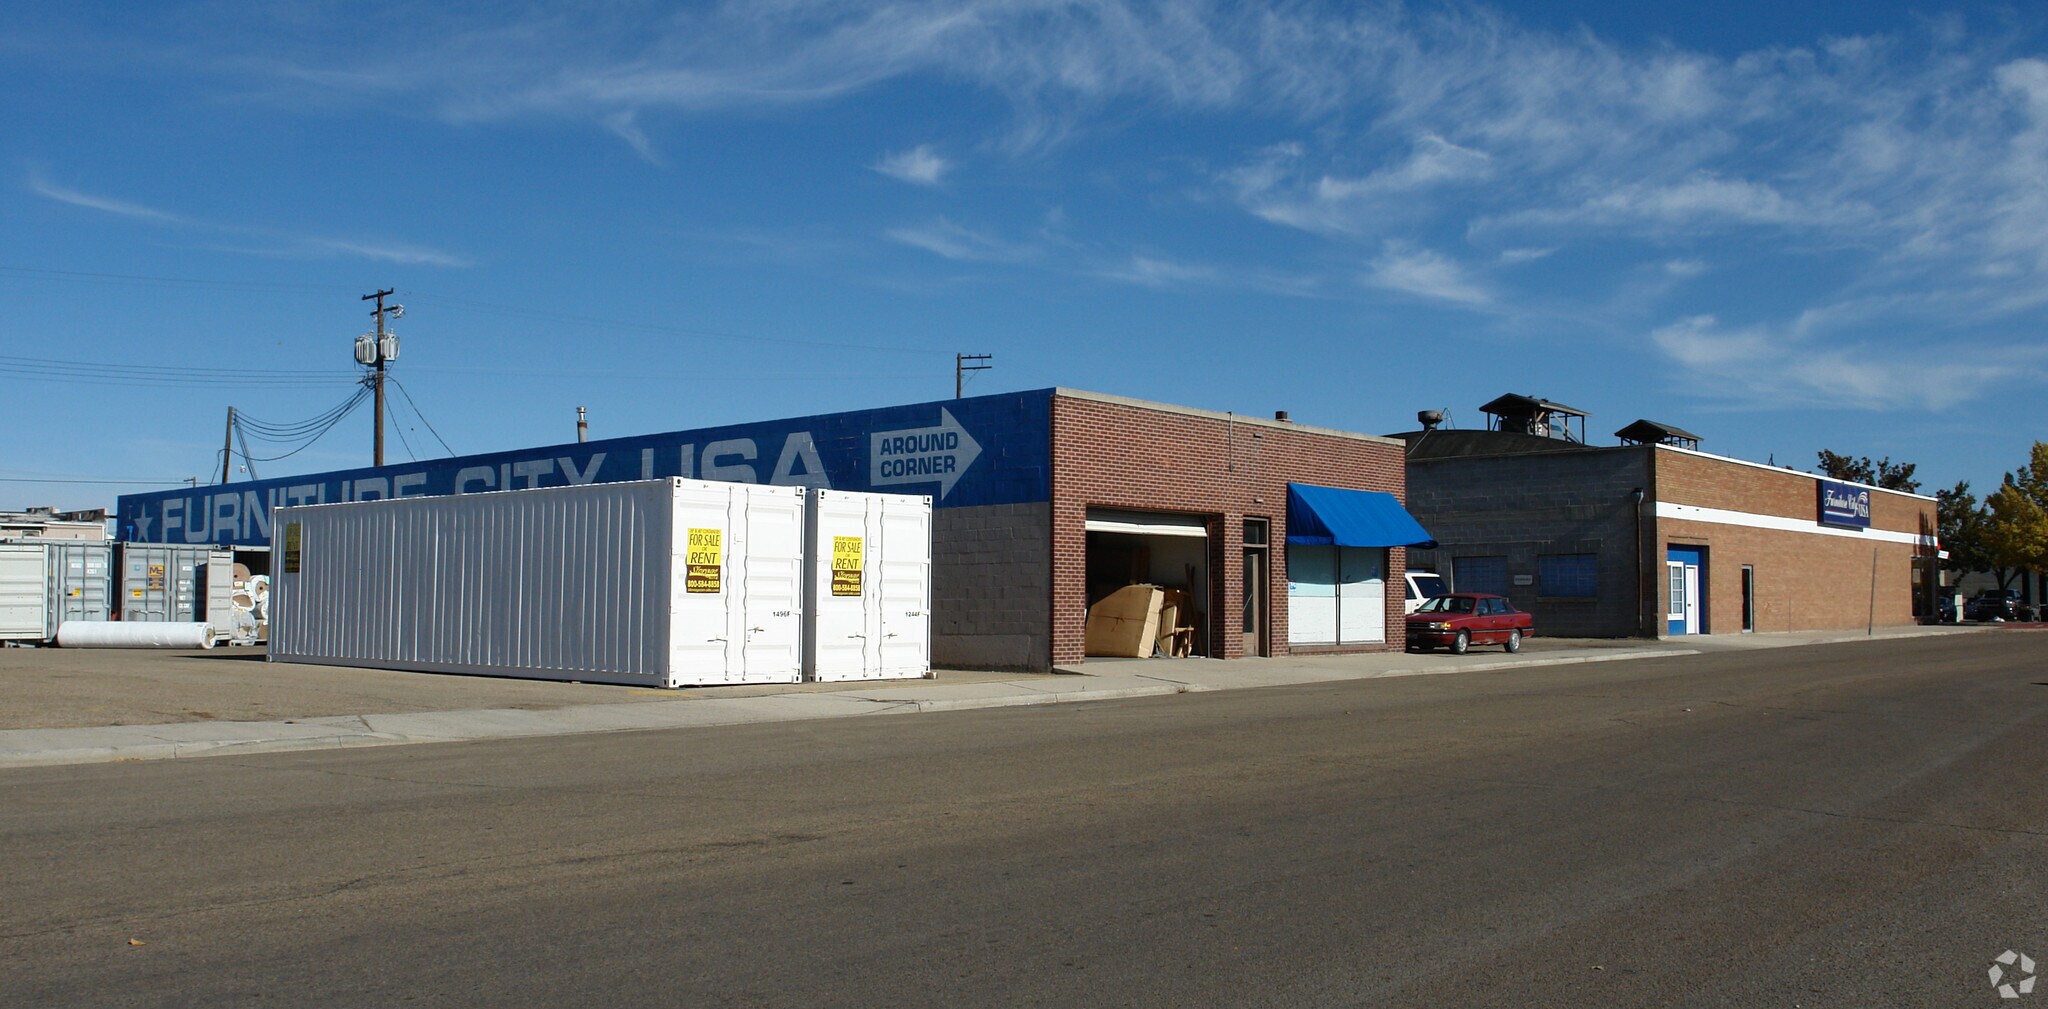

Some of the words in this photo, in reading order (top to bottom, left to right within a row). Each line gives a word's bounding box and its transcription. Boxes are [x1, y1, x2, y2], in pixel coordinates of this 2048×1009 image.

[880, 432, 959, 456] AROUND
[880, 455, 956, 478] CORNER
[1858, 504, 1869, 518] USA
[689, 534, 703, 546] FOR
[704, 534, 720, 547] SALE
[834, 541, 846, 553] FOR
[847, 542, 861, 553] SALE
[690, 552, 718, 564] RENT
[835, 558, 859, 570] RENT
